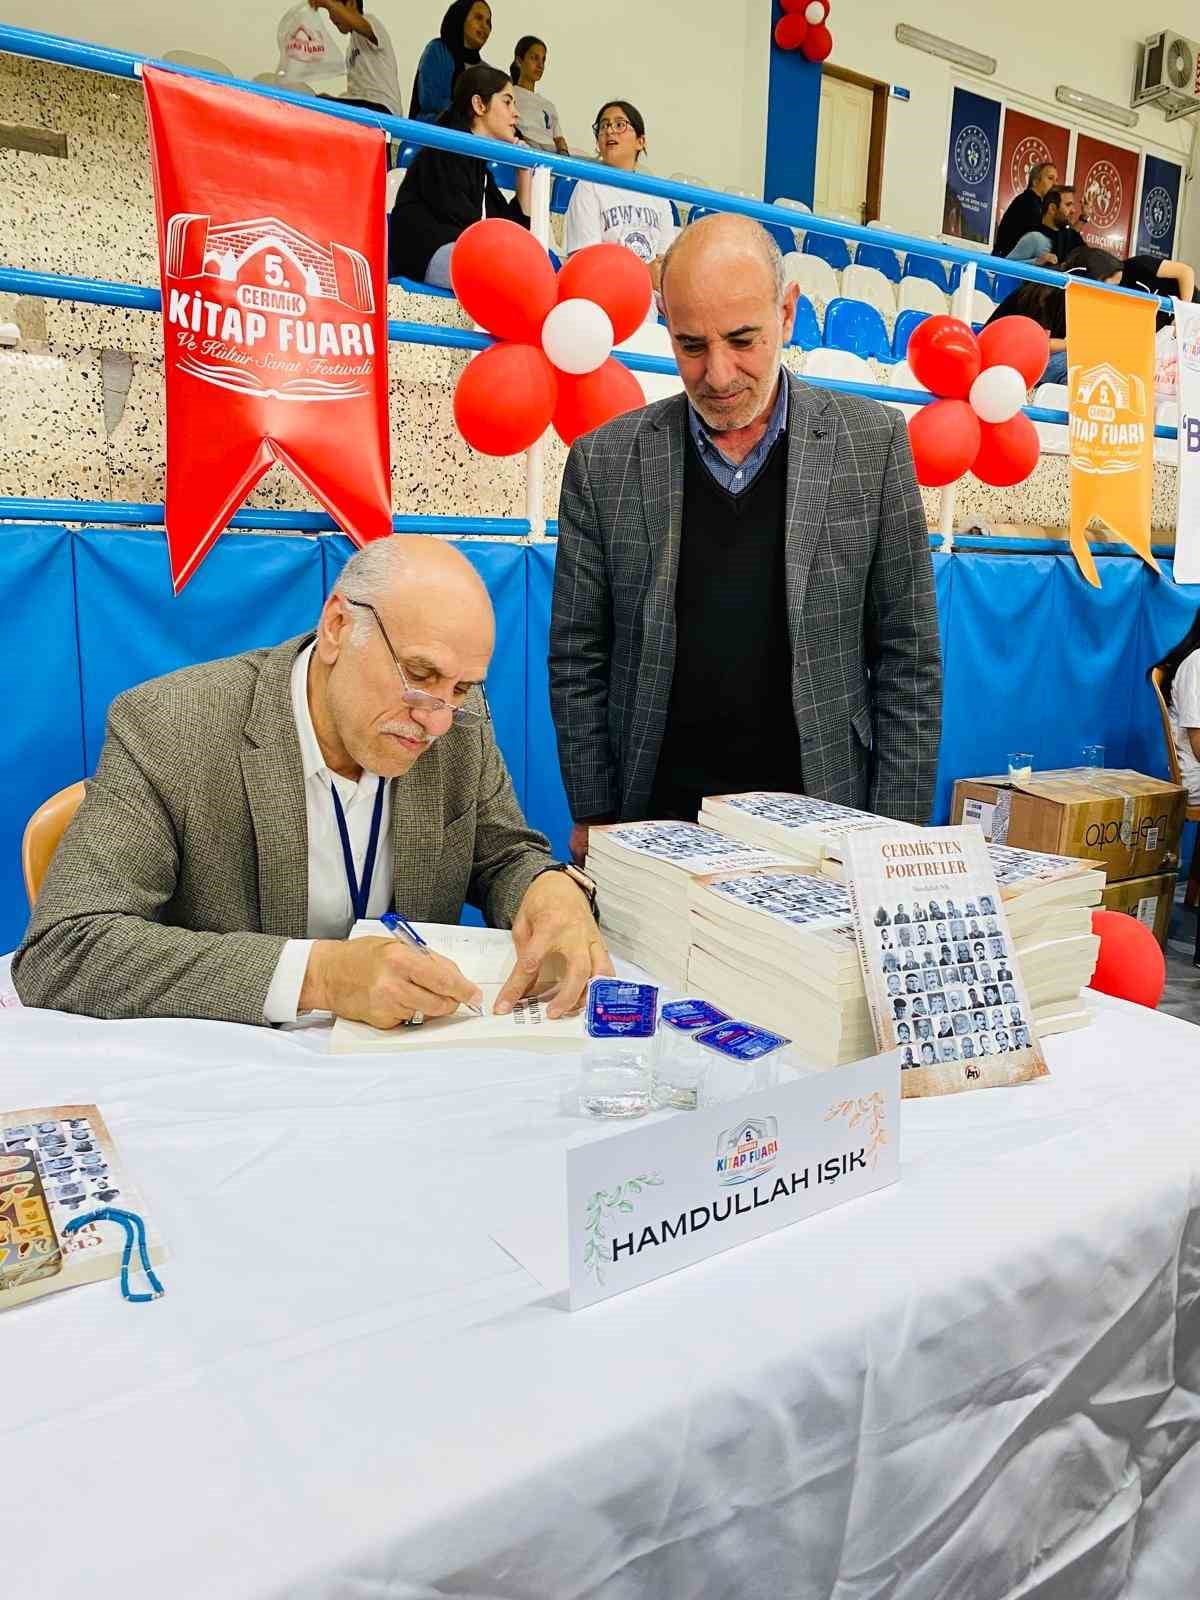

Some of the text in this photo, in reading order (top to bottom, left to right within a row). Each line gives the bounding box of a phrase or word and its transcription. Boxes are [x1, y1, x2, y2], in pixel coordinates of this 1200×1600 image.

[601, 205, 632, 232] NEW
[264, 254, 291, 288] 5.
[168, 288, 375, 356] KİTAP FUARI
[176, 331, 198, 351] Ve
[886, 860, 968, 880] PORTRELER
[749, 1140, 778, 1162] FUARI
[612, 1148, 867, 1262] HAMDULLAH IŞIK
